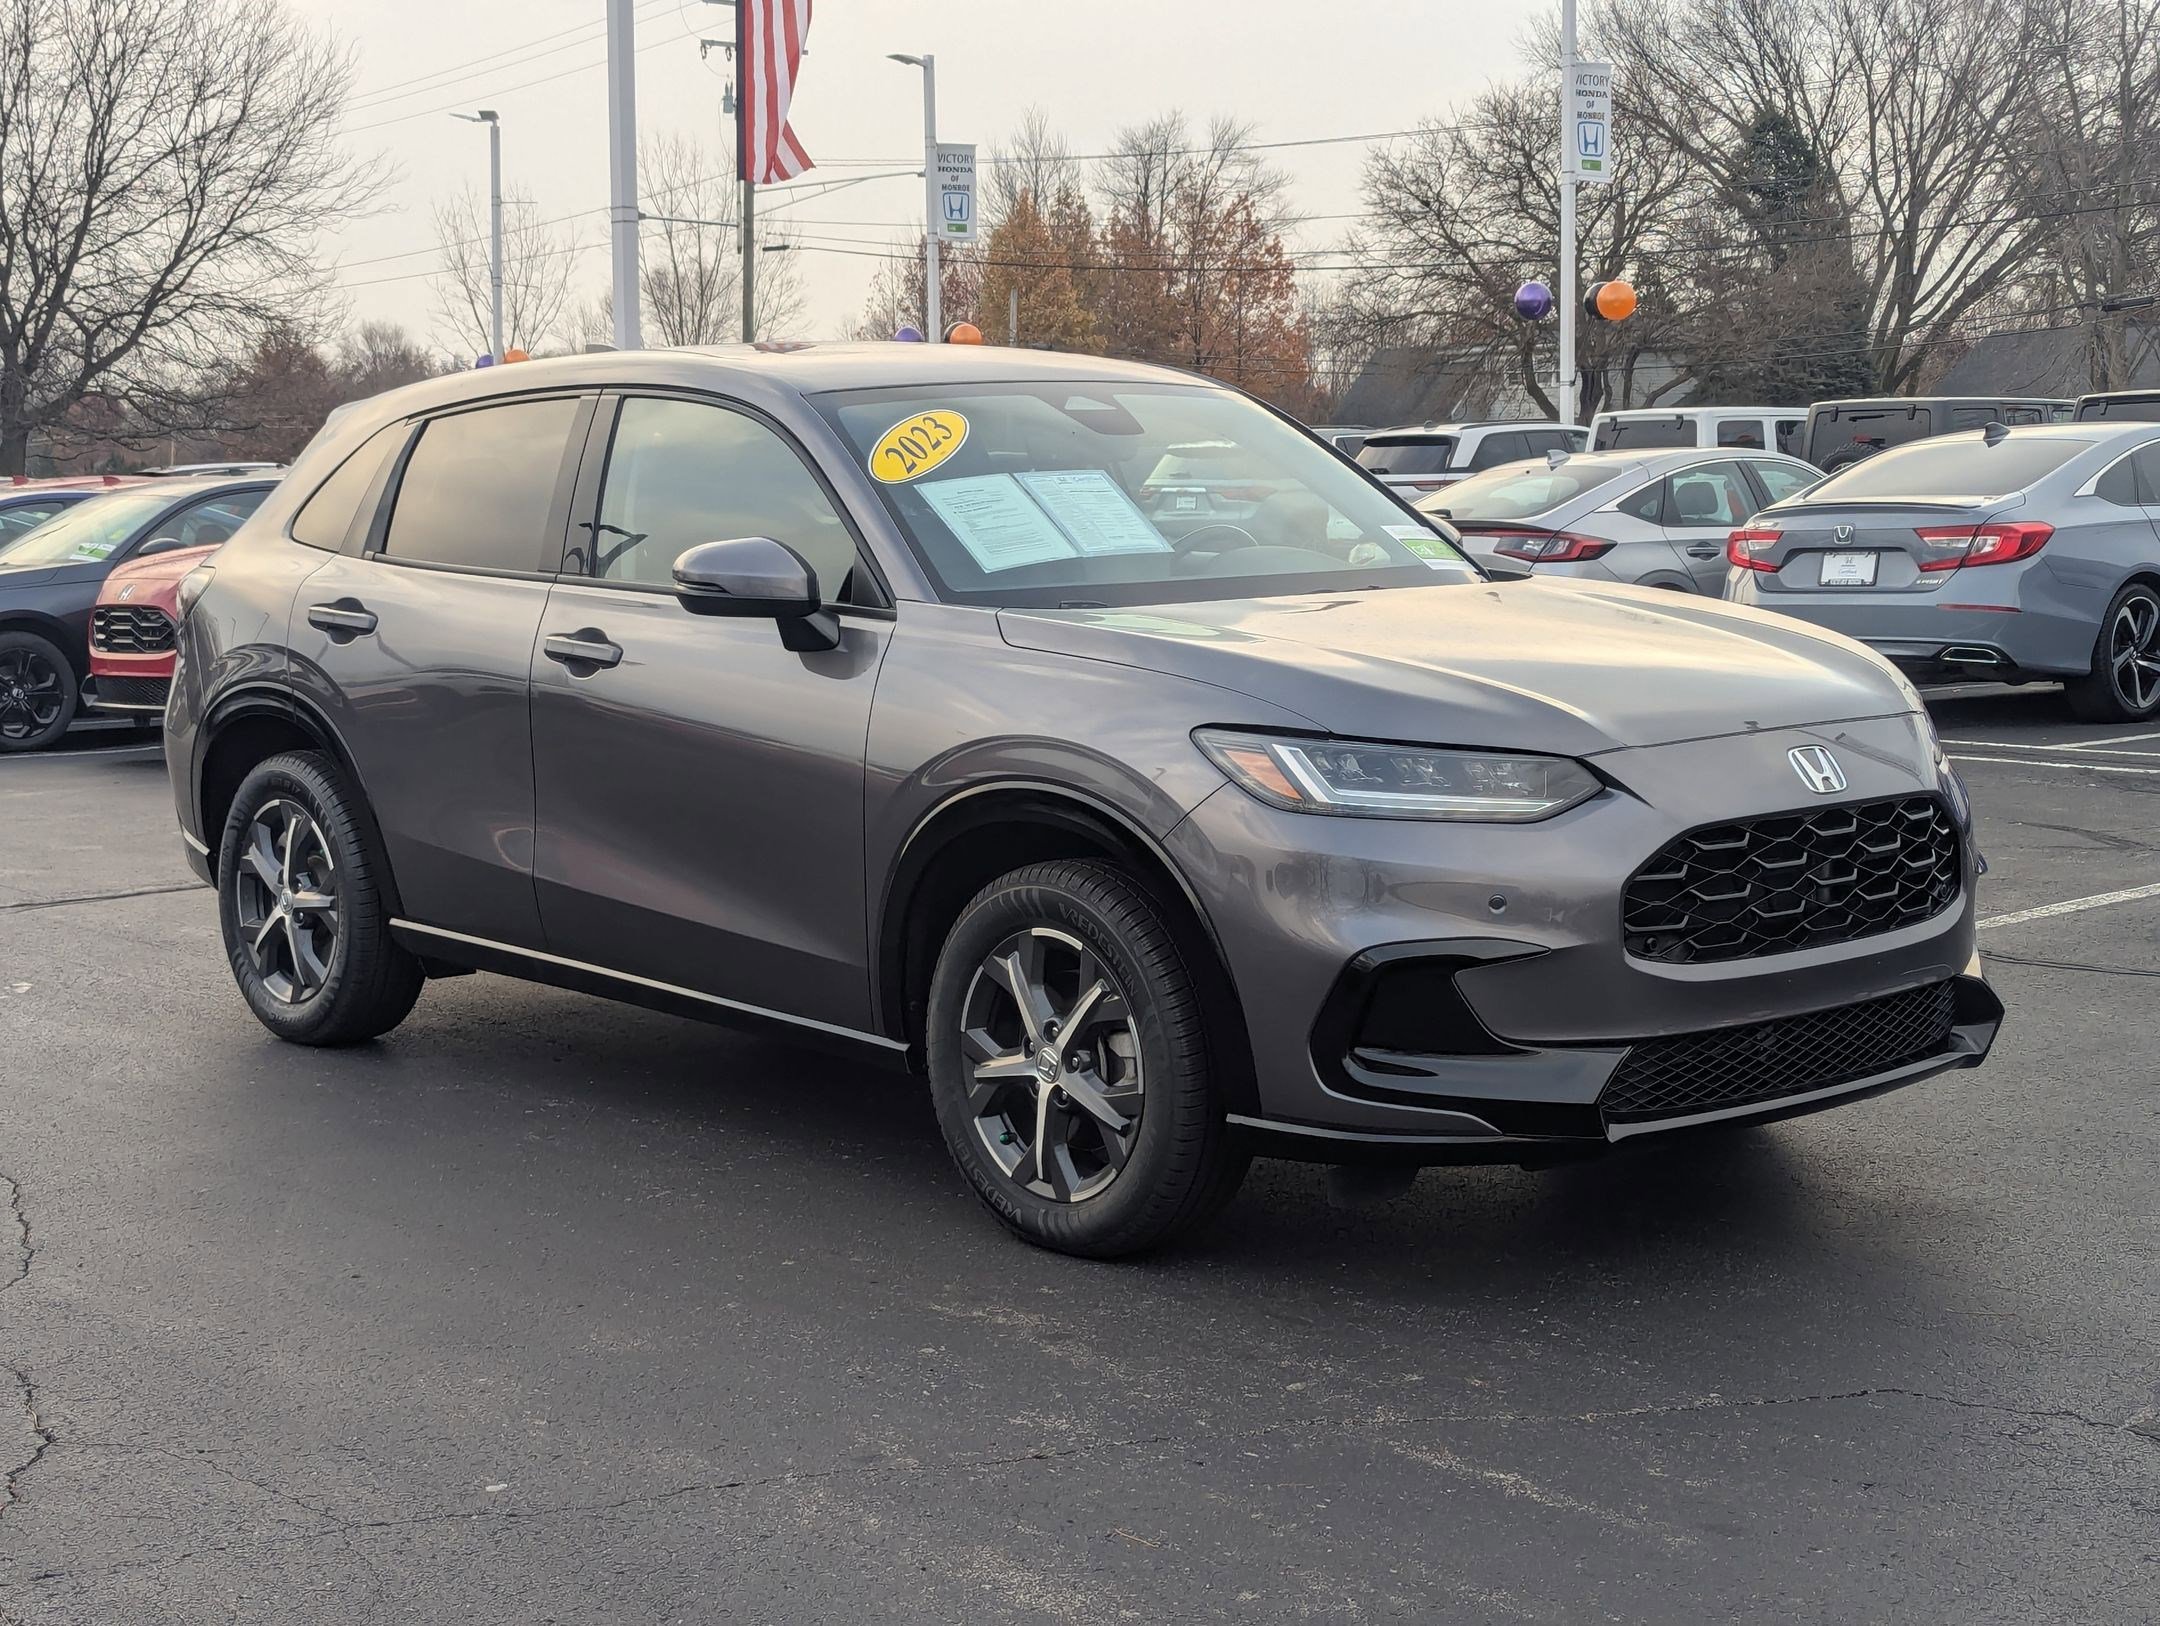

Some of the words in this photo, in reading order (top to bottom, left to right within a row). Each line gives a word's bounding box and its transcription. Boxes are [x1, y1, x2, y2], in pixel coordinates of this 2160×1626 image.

[1575, 89, 1608, 98] HONDA
[1586, 100, 1595, 109] OF
[937, 153, 975, 164] VICTORY
[885, 416, 952, 474] 2023
